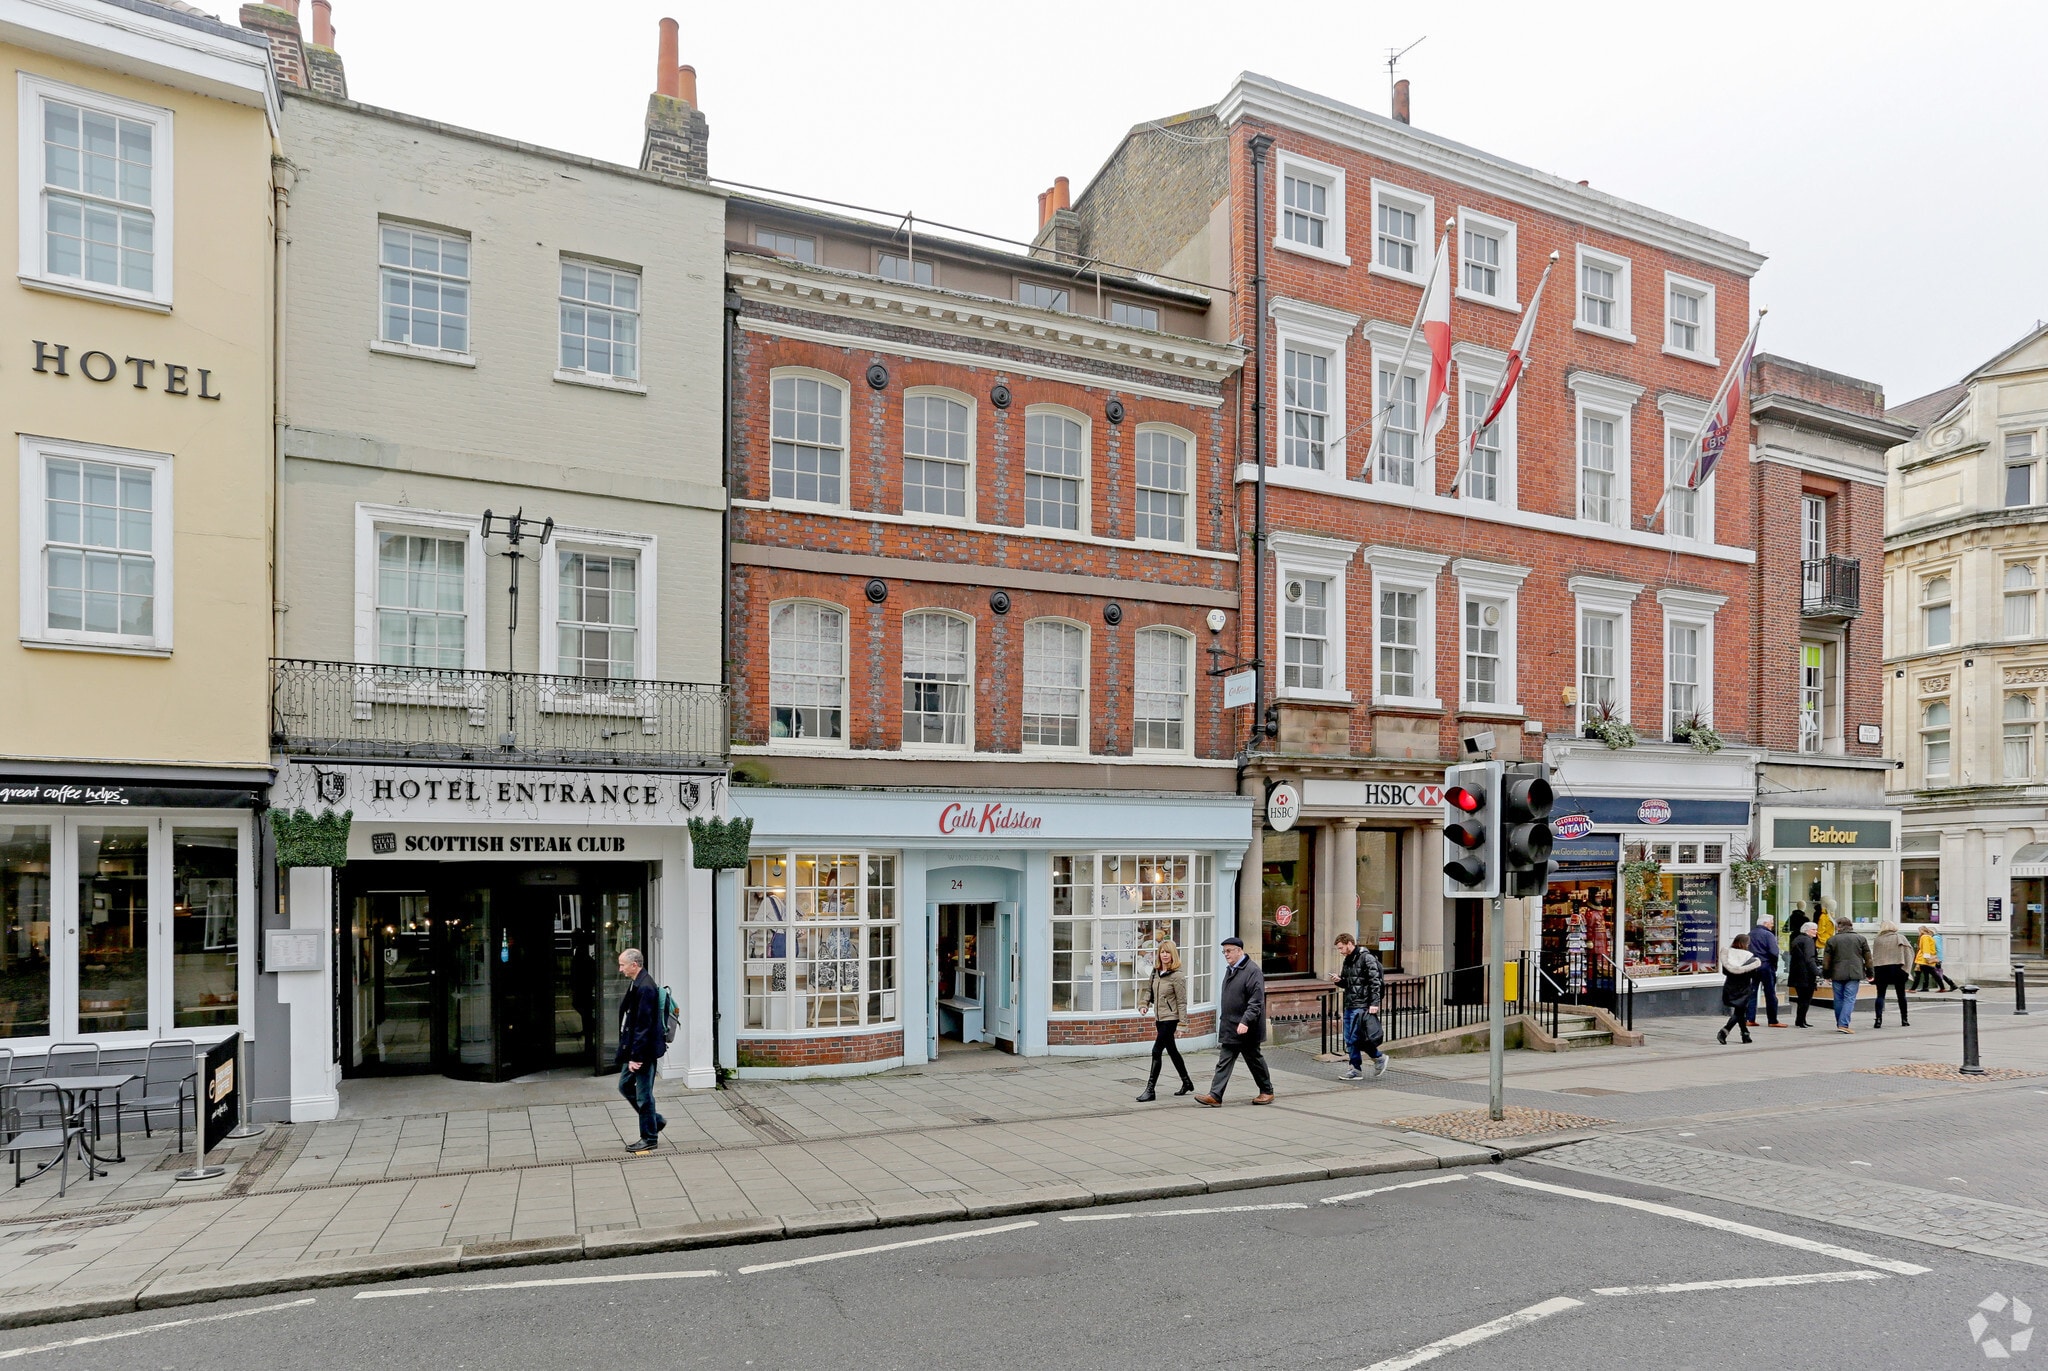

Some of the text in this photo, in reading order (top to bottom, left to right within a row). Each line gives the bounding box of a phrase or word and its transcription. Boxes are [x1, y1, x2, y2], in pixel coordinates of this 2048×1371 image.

[32, 339, 221, 401] HOTEL
[0, 785, 121, 804] great coffee helps
[373, 779, 658, 805] HOTEL ENTRANCE
[1365, 784, 1416, 806] HSBC
[938, 802, 1042, 835] Cath Kidston
[1270, 807, 1294, 819] HSBC
[1556, 816, 1586, 826] GLORIOUS
[1639, 808, 1672, 819] BRITAIN
[1558, 820, 1592, 835] RITAIN
[1809, 825, 1858, 844] Barbour
[405, 836, 625, 852] SCOTTISH STEAK CLUB
[951, 879, 963, 890] 24
[1494, 900, 1501, 910] 2
